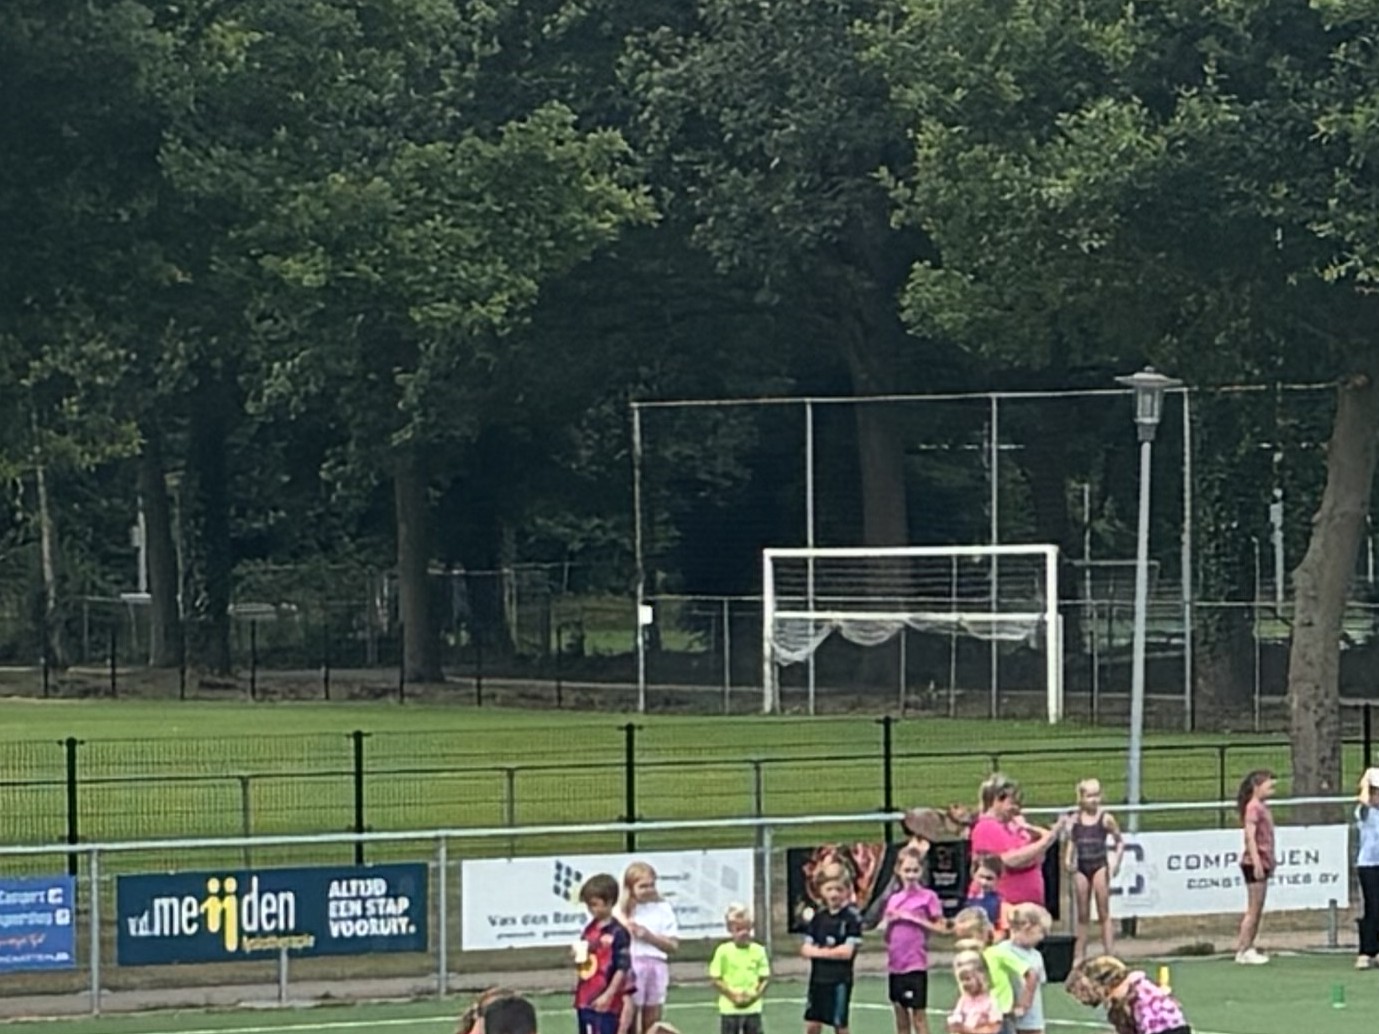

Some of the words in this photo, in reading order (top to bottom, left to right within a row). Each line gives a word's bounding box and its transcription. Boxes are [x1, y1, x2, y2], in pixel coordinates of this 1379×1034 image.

[328, 878, 388, 898] ALTIJD
[328, 899, 364, 918] EEN
[365, 897, 410, 916] STAP
